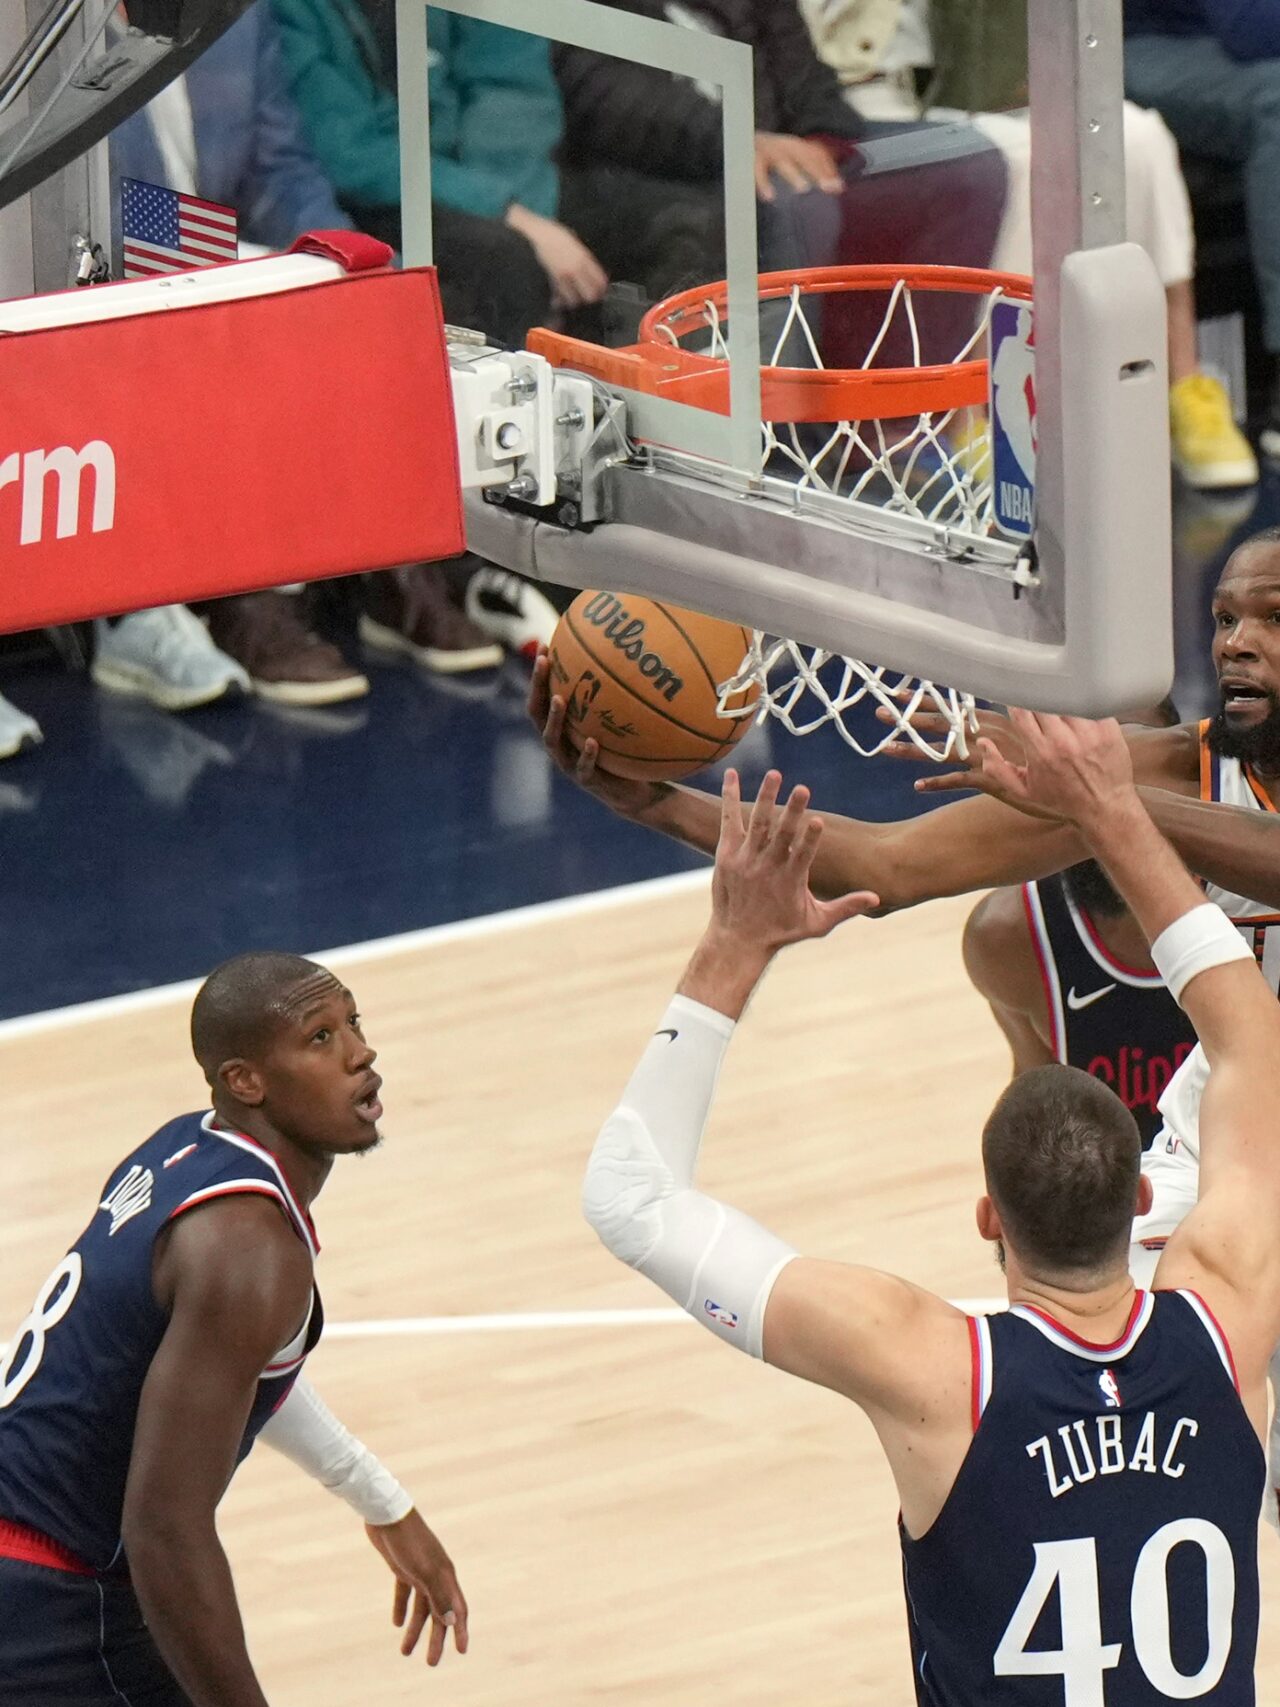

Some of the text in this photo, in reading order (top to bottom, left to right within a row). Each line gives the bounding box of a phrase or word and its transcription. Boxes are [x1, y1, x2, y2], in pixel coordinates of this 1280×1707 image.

[1000, 480, 1033, 525] NBA
[583, 591, 684, 702] Wilson
[0, 1251, 82, 1409] 8
[1025, 1411, 1199, 1499] ZUBAC
[993, 1517, 1236, 1707] 40
